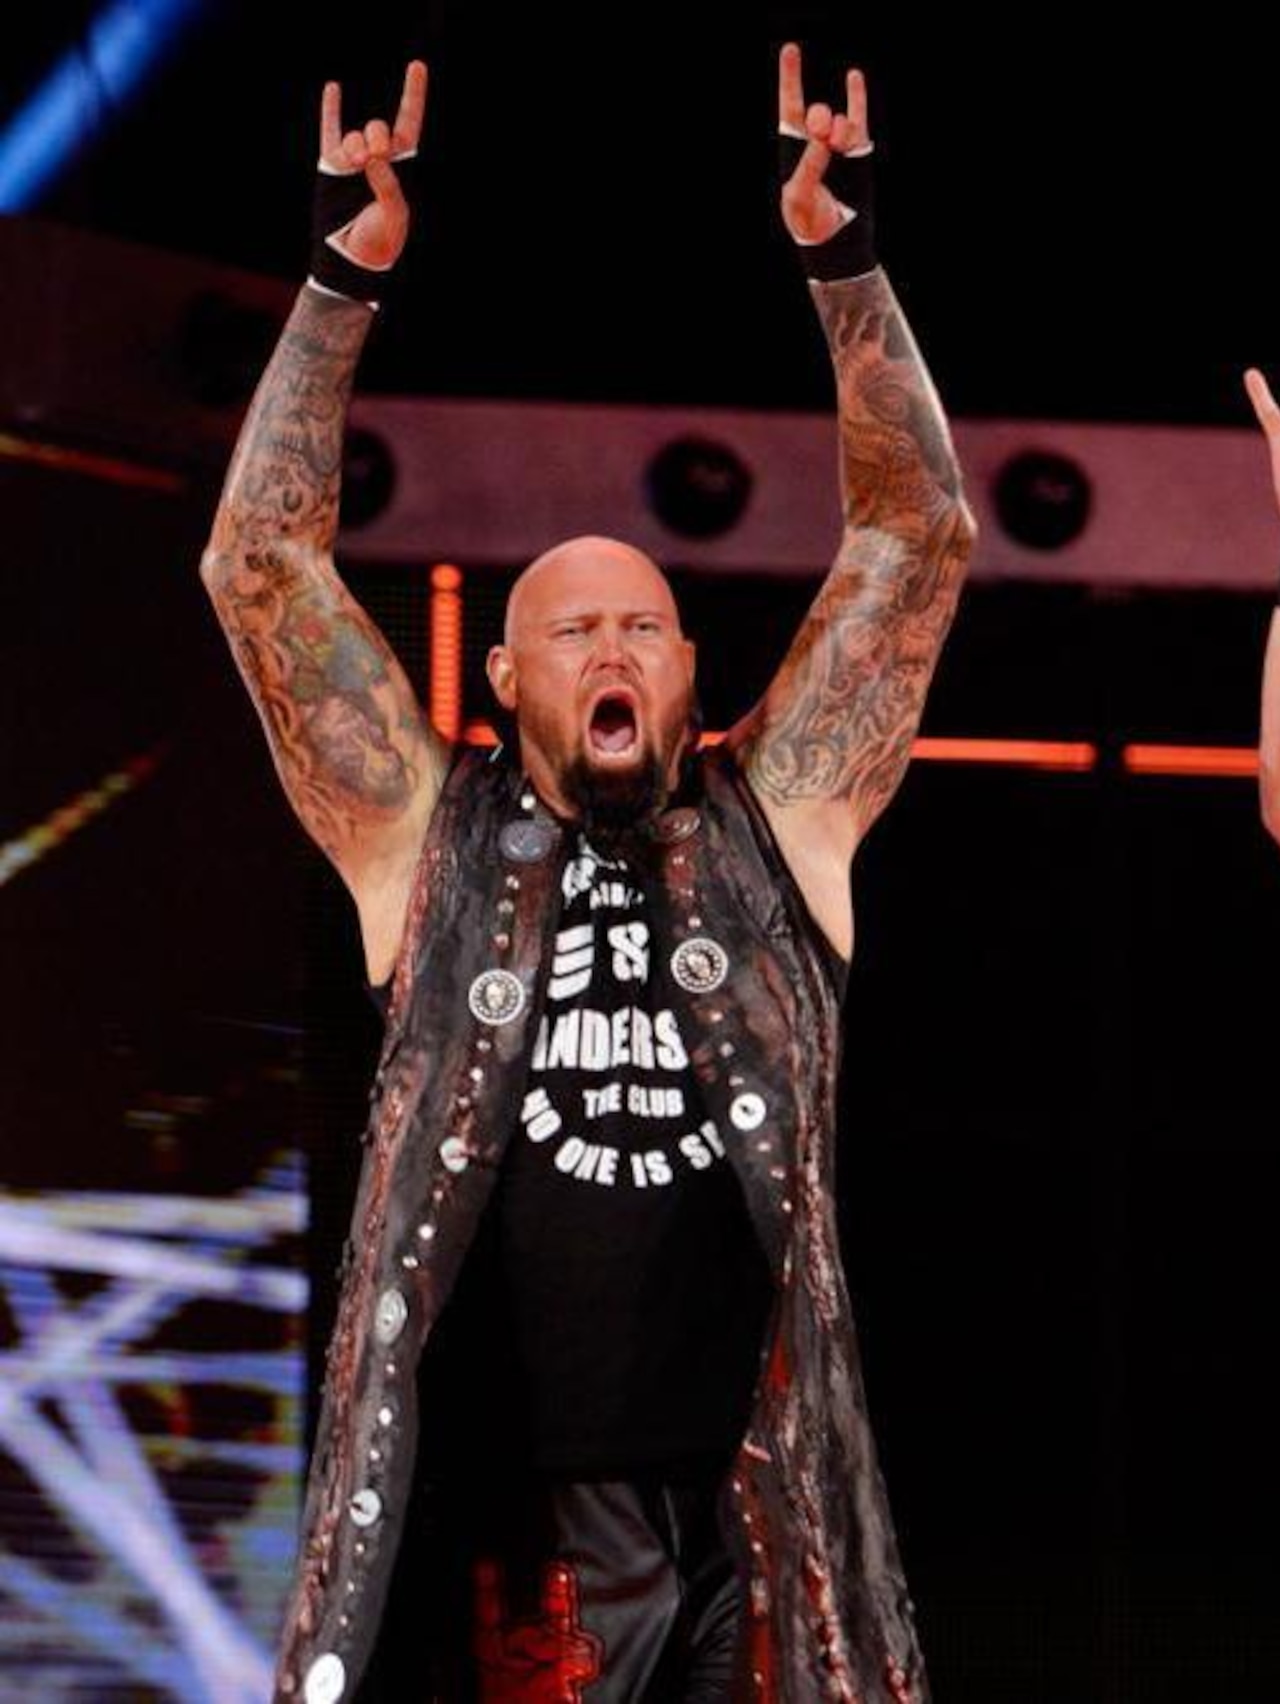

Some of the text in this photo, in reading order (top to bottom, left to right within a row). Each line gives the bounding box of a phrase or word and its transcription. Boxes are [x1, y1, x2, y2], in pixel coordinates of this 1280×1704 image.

[627, 1084, 685, 1118] CLUB
[554, 1136, 620, 1186] ONE
[630, 1150, 673, 1188] IS
